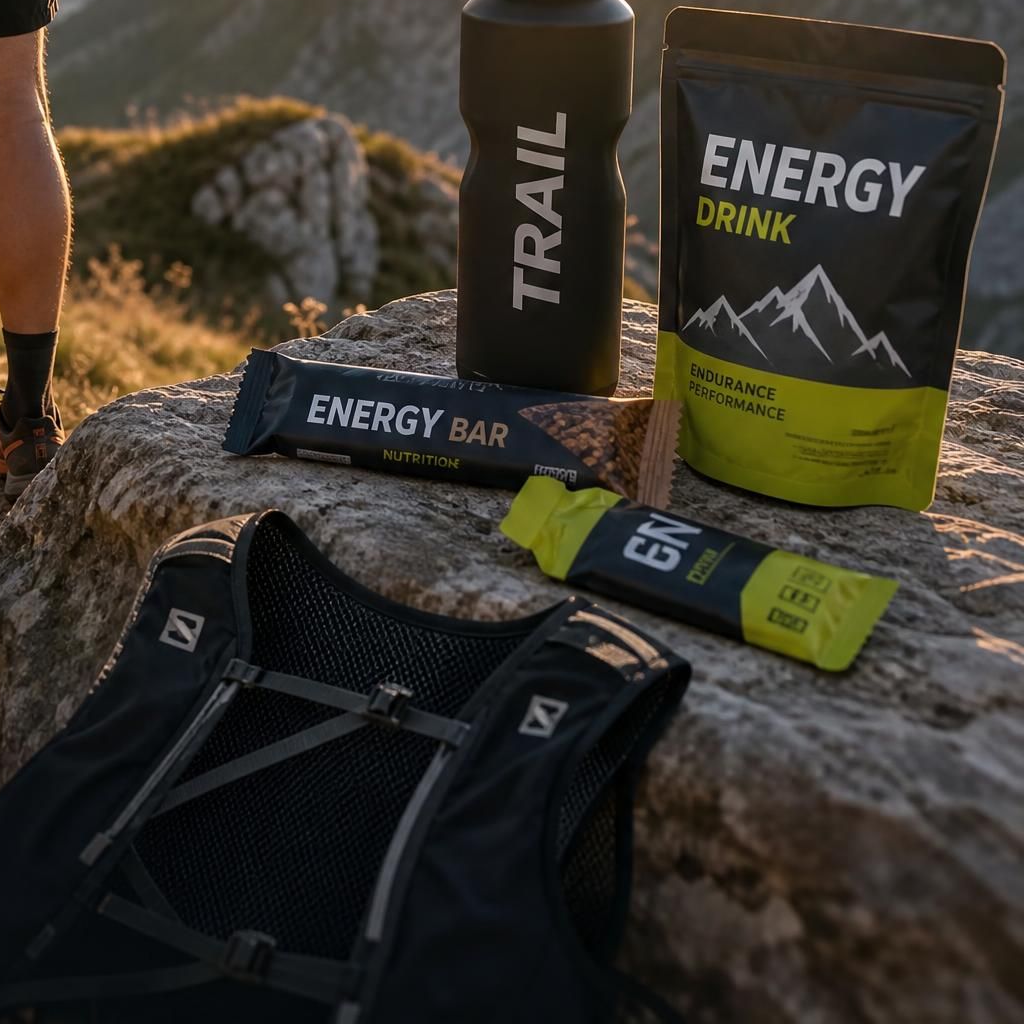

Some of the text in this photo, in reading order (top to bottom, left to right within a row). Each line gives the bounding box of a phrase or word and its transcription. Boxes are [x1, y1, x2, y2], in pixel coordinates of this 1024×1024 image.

[700, 133, 927, 218] ENERGY
[512, 111, 567, 311] TRAIL
[696, 196, 796, 245] DRINK
[688, 380, 786, 422] PERFORMANCE
[690, 363, 777, 401] ENDURANCE
[306, 394, 509, 449] ENERGY BAR
